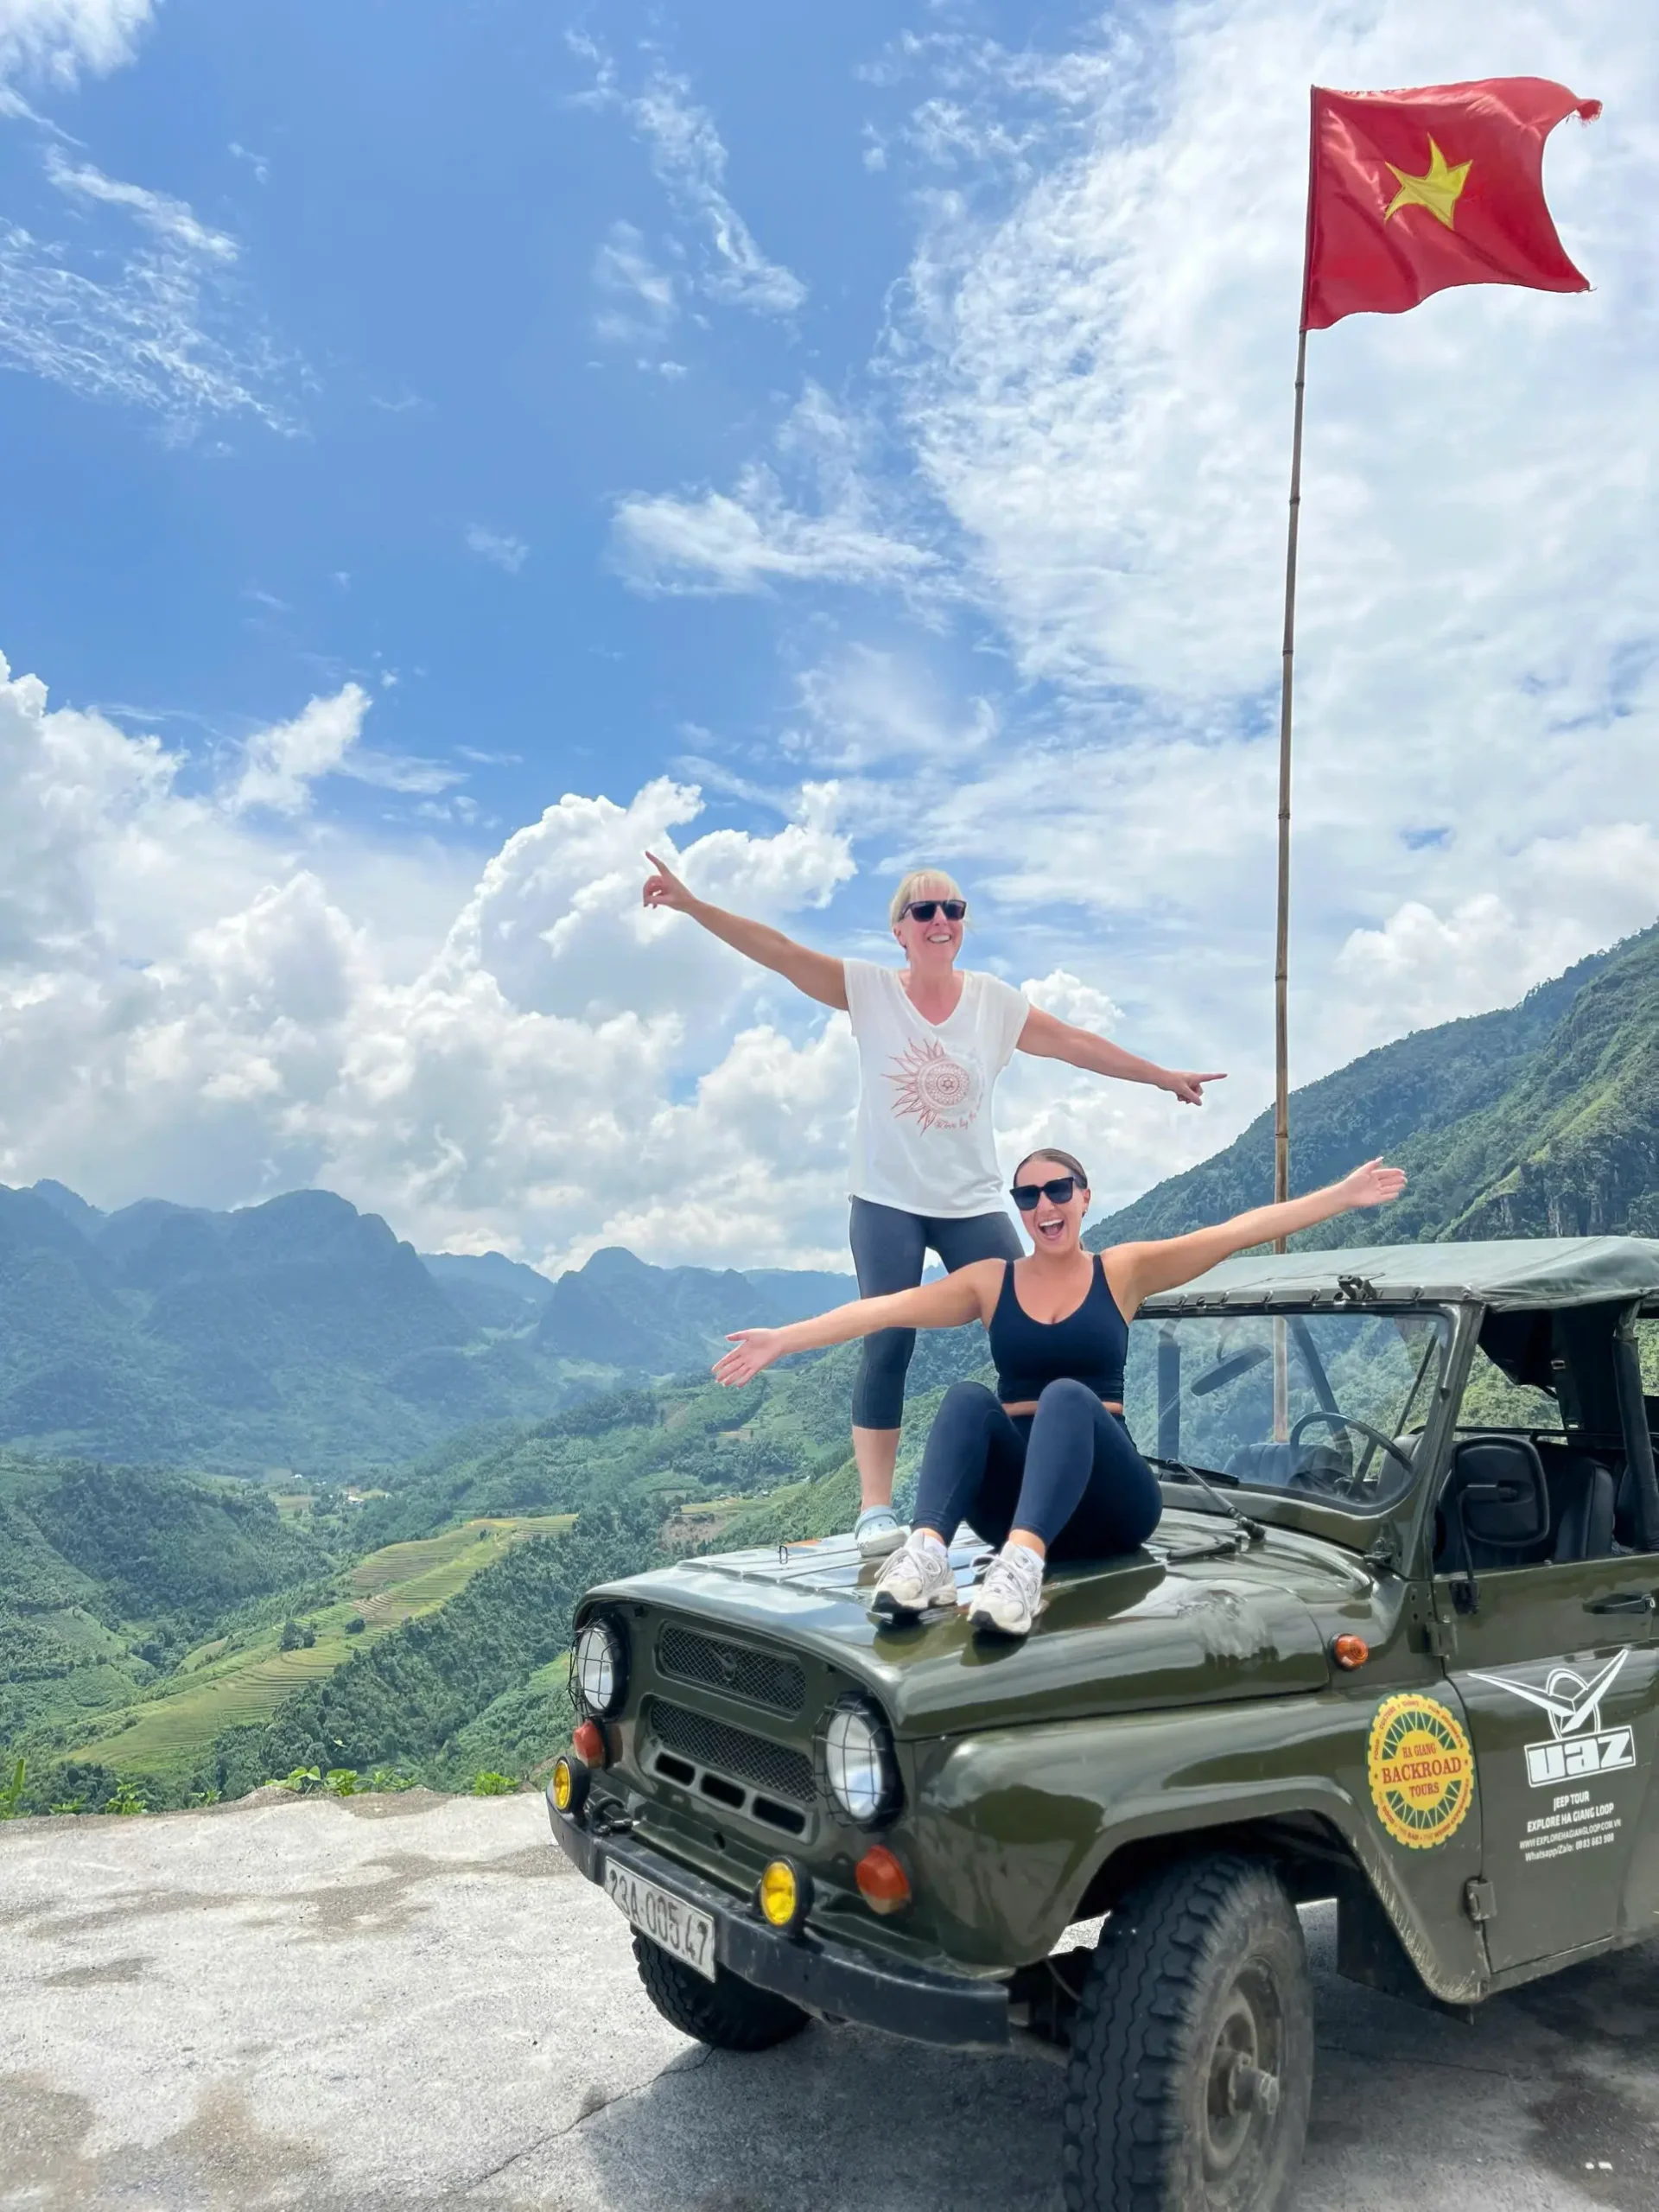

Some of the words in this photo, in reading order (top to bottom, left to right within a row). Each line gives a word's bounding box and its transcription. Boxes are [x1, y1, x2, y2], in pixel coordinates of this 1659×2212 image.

[1402, 1746, 1413, 1758] HA
[1414, 1742, 1437, 1757] GIANG
[1381, 1757, 1462, 1784] BACKROAD
[1408, 1782, 1440, 1798] TOURS
[1553, 1795, 1570, 1812] JEEP
[1569, 1790, 1590, 1806] TOUR
[1527, 1815, 1560, 1833] EXPLORE
[1560, 1812, 1573, 1825] HA
[1573, 1807, 1595, 1822] GIANG
[1595, 1802, 1614, 1817] LOOP
